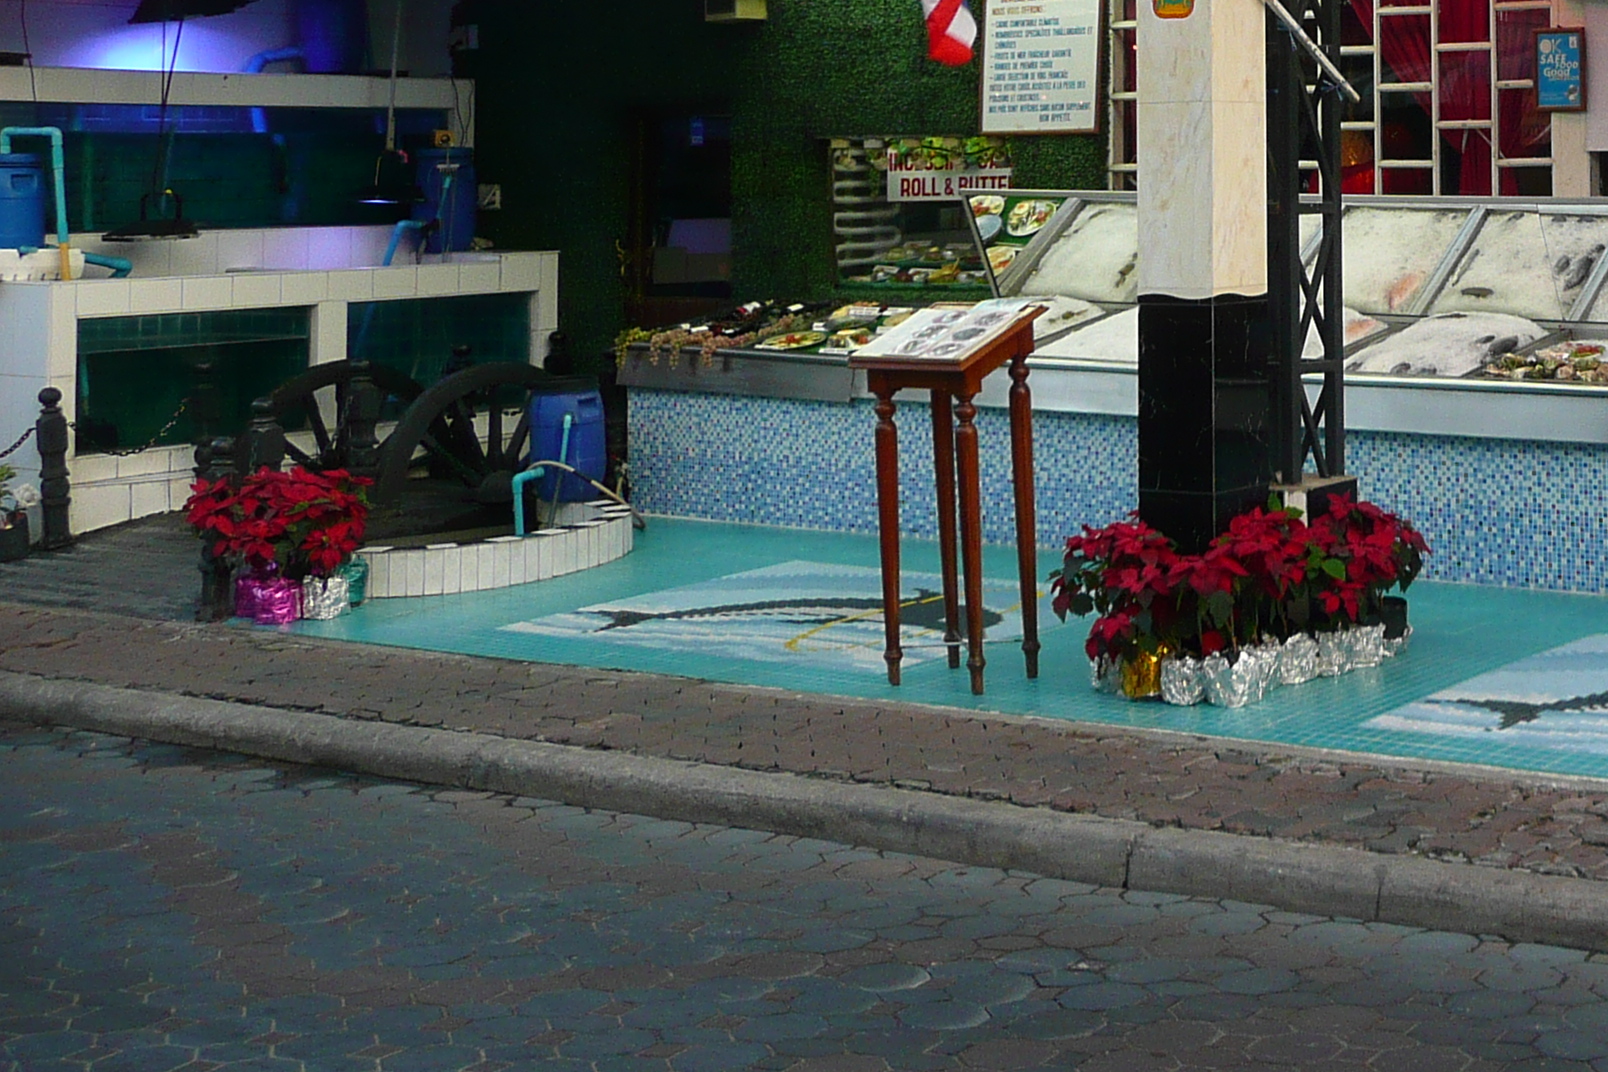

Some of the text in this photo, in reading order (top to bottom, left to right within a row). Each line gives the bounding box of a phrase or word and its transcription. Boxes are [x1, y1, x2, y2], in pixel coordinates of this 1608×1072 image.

[1540, 54, 1567, 64] SAFE
[901, 177, 940, 197] ROLL
[944, 177, 954, 196] &
